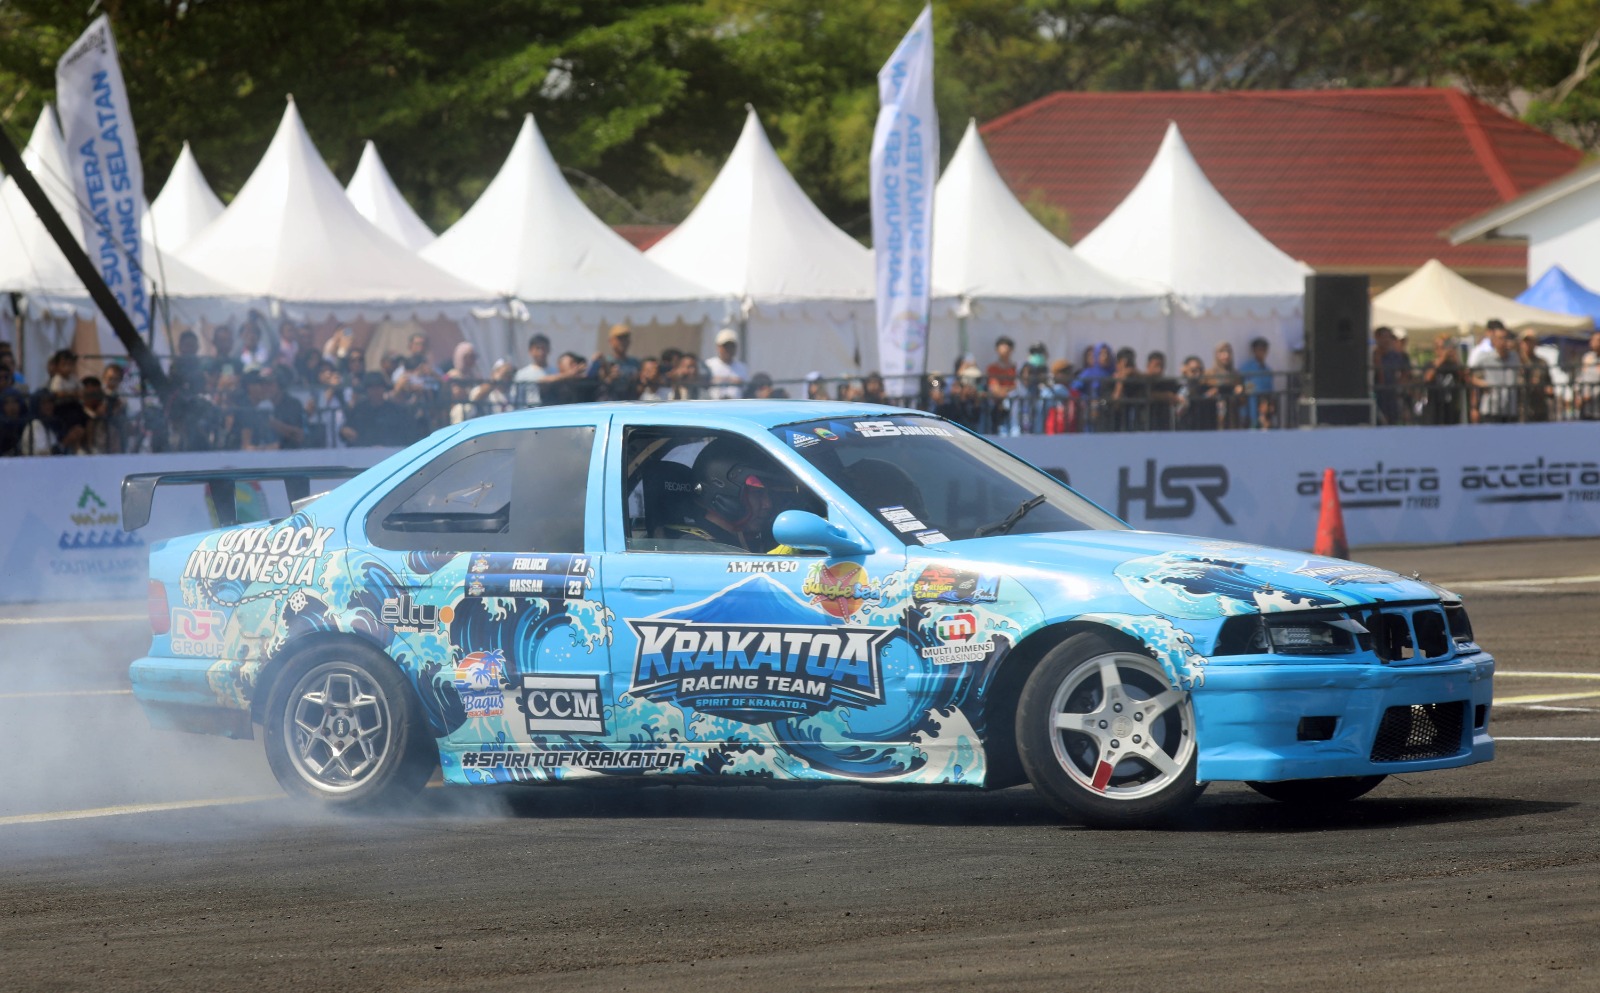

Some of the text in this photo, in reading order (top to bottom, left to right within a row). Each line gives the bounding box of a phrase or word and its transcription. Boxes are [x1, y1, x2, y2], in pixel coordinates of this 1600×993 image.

[92, 71, 131, 194] SELATAN
[79, 138, 124, 287] SUMATERA
[115, 196, 149, 333] LAMPUNG
[1296, 461, 1440, 496] acelera
[1116, 458, 1237, 527] HSR
[217, 525, 335, 558] UNLOCK
[183, 550, 317, 586] INDONESIA
[572, 558, 588, 573] 21
[509, 579, 583, 596] HASSAN 23
[853, 582, 881, 600] Sea
[172, 640, 226, 657] GROUP
[637, 625, 877, 689] KRAKATOA
[924, 643, 993, 656] MULTI DIMENSI
[934, 652, 984, 664] KREASINDO
[681, 674, 827, 697] RACING TEAM
[463, 693, 504, 714] Bagus
[527, 690, 600, 718] CCM
[696, 698, 808, 710] SPIRIT OF KRAKATOA
[462, 751, 687, 768] #SPIRITOFKRAKATOA
